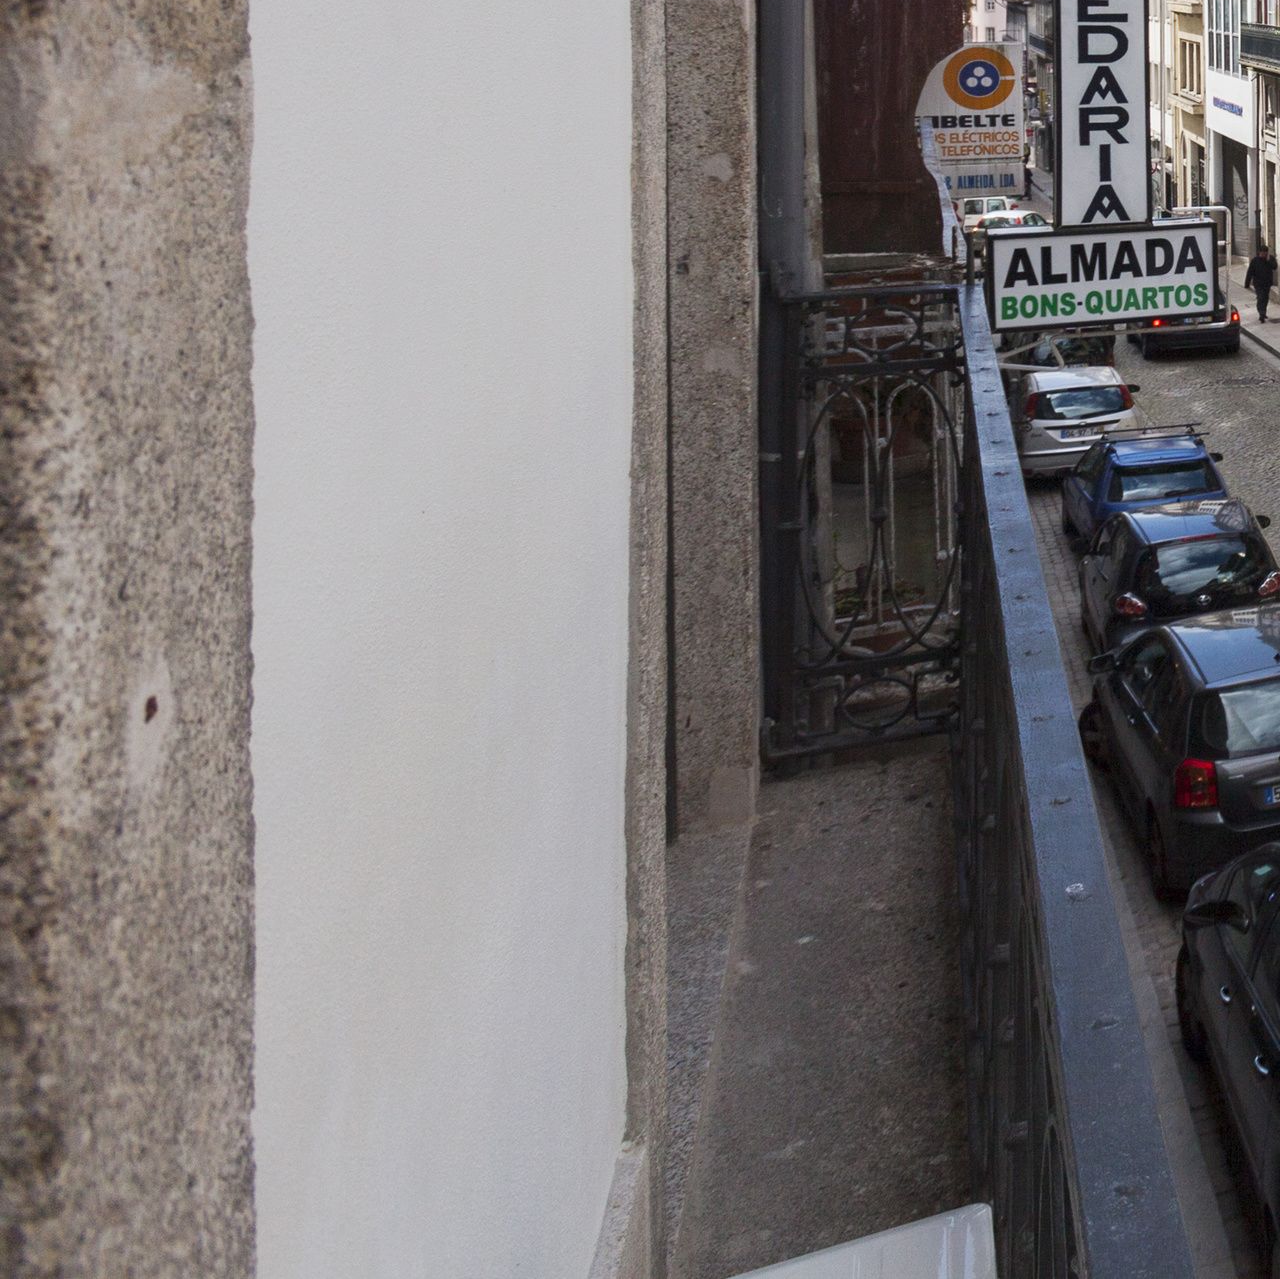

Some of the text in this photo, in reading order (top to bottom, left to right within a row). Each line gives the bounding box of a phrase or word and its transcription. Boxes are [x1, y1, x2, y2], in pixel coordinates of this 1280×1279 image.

[949, 129, 1019, 144] ELÉCTRICOS
[1003, 235, 1207, 288] ALMADA
[1001, 283, 1208, 320] BONS-QUARTOS
